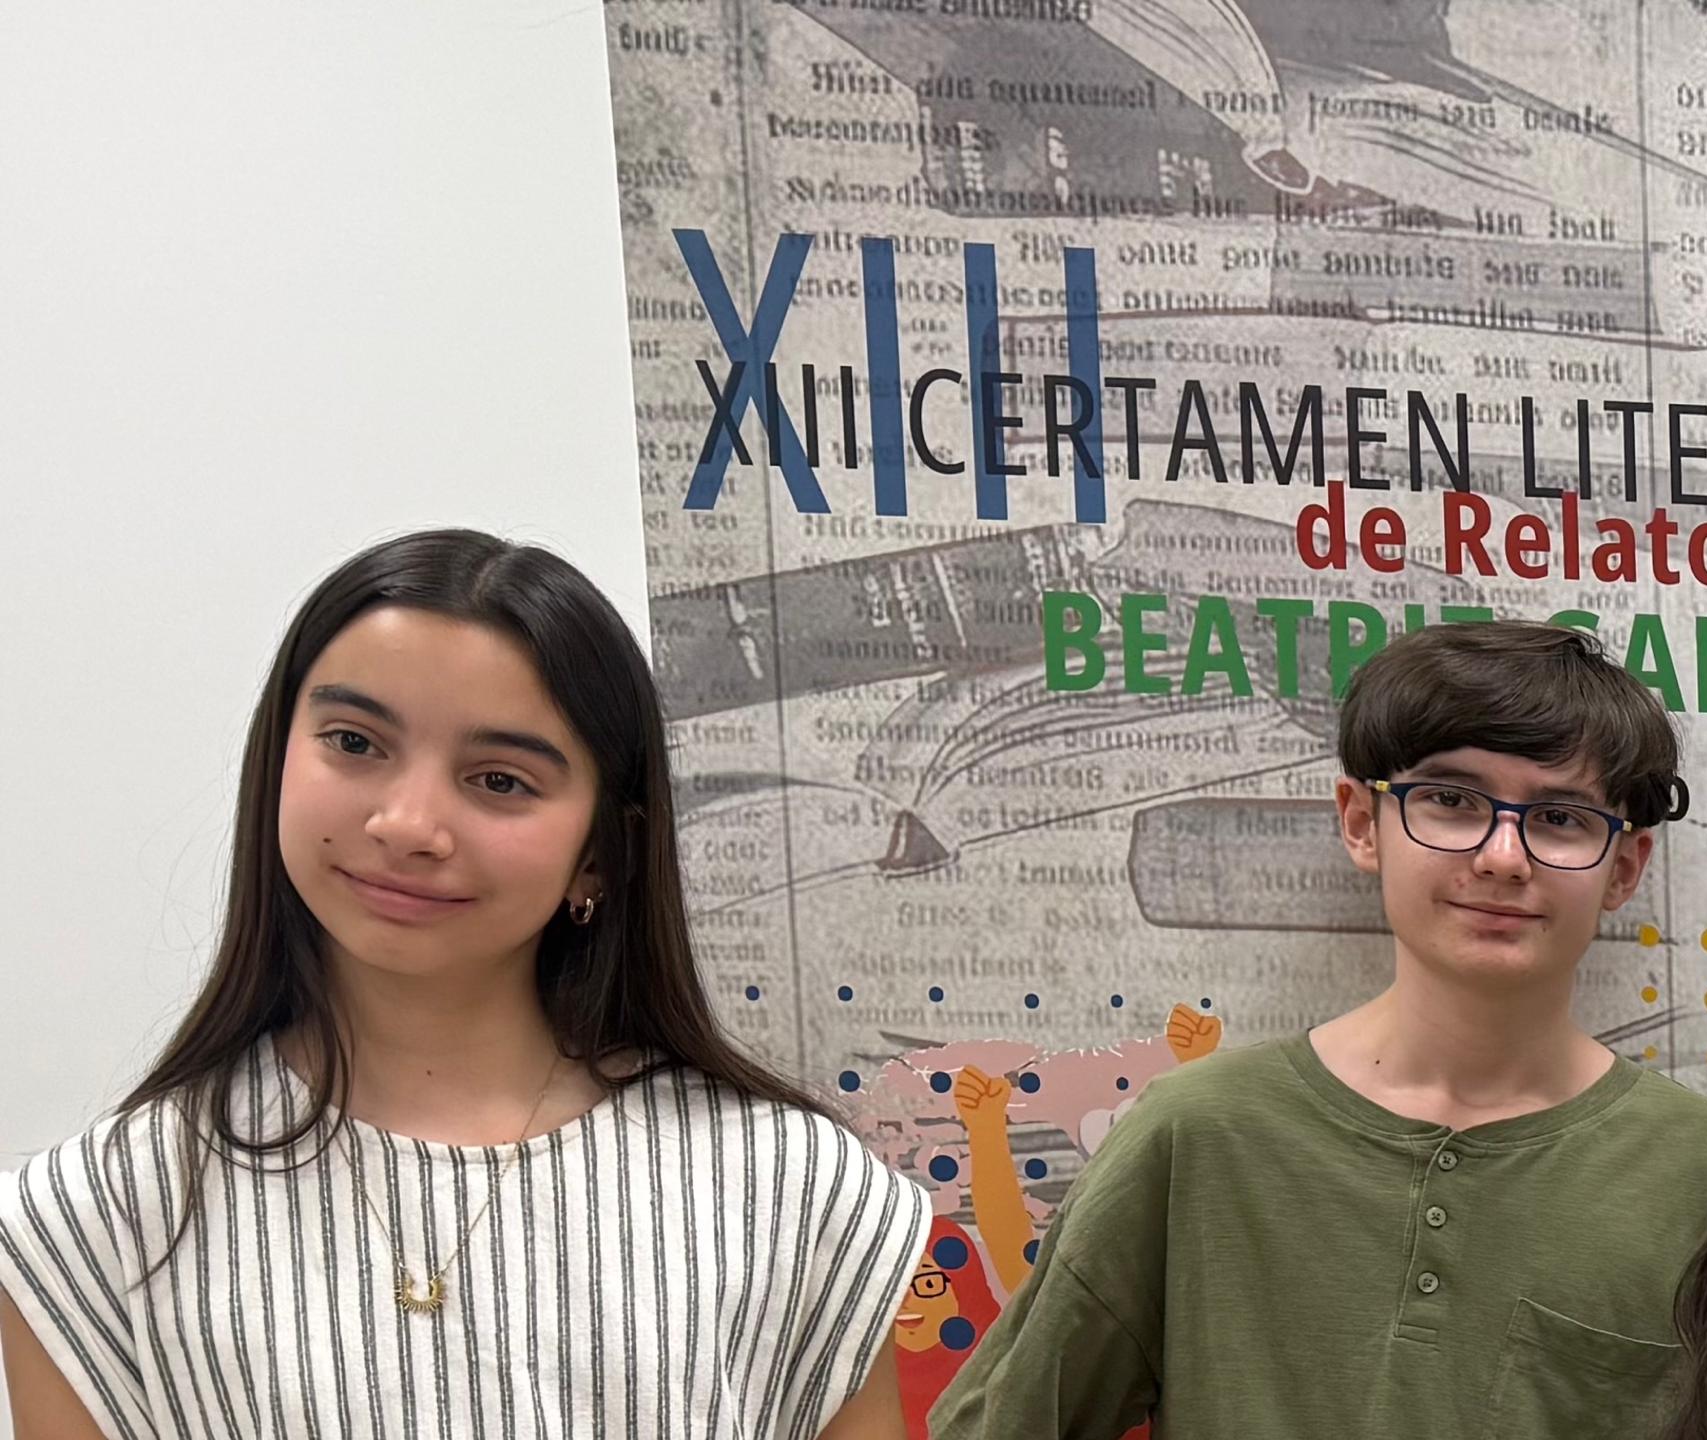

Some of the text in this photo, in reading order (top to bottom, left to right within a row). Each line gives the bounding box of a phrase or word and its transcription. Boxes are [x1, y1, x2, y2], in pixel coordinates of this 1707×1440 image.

[695, 359, 859, 470] XIII
[909, 367, 1470, 493] CERTAMEN
[1296, 480, 1408, 572] de
[1043, 590, 1494, 701] BEATR
